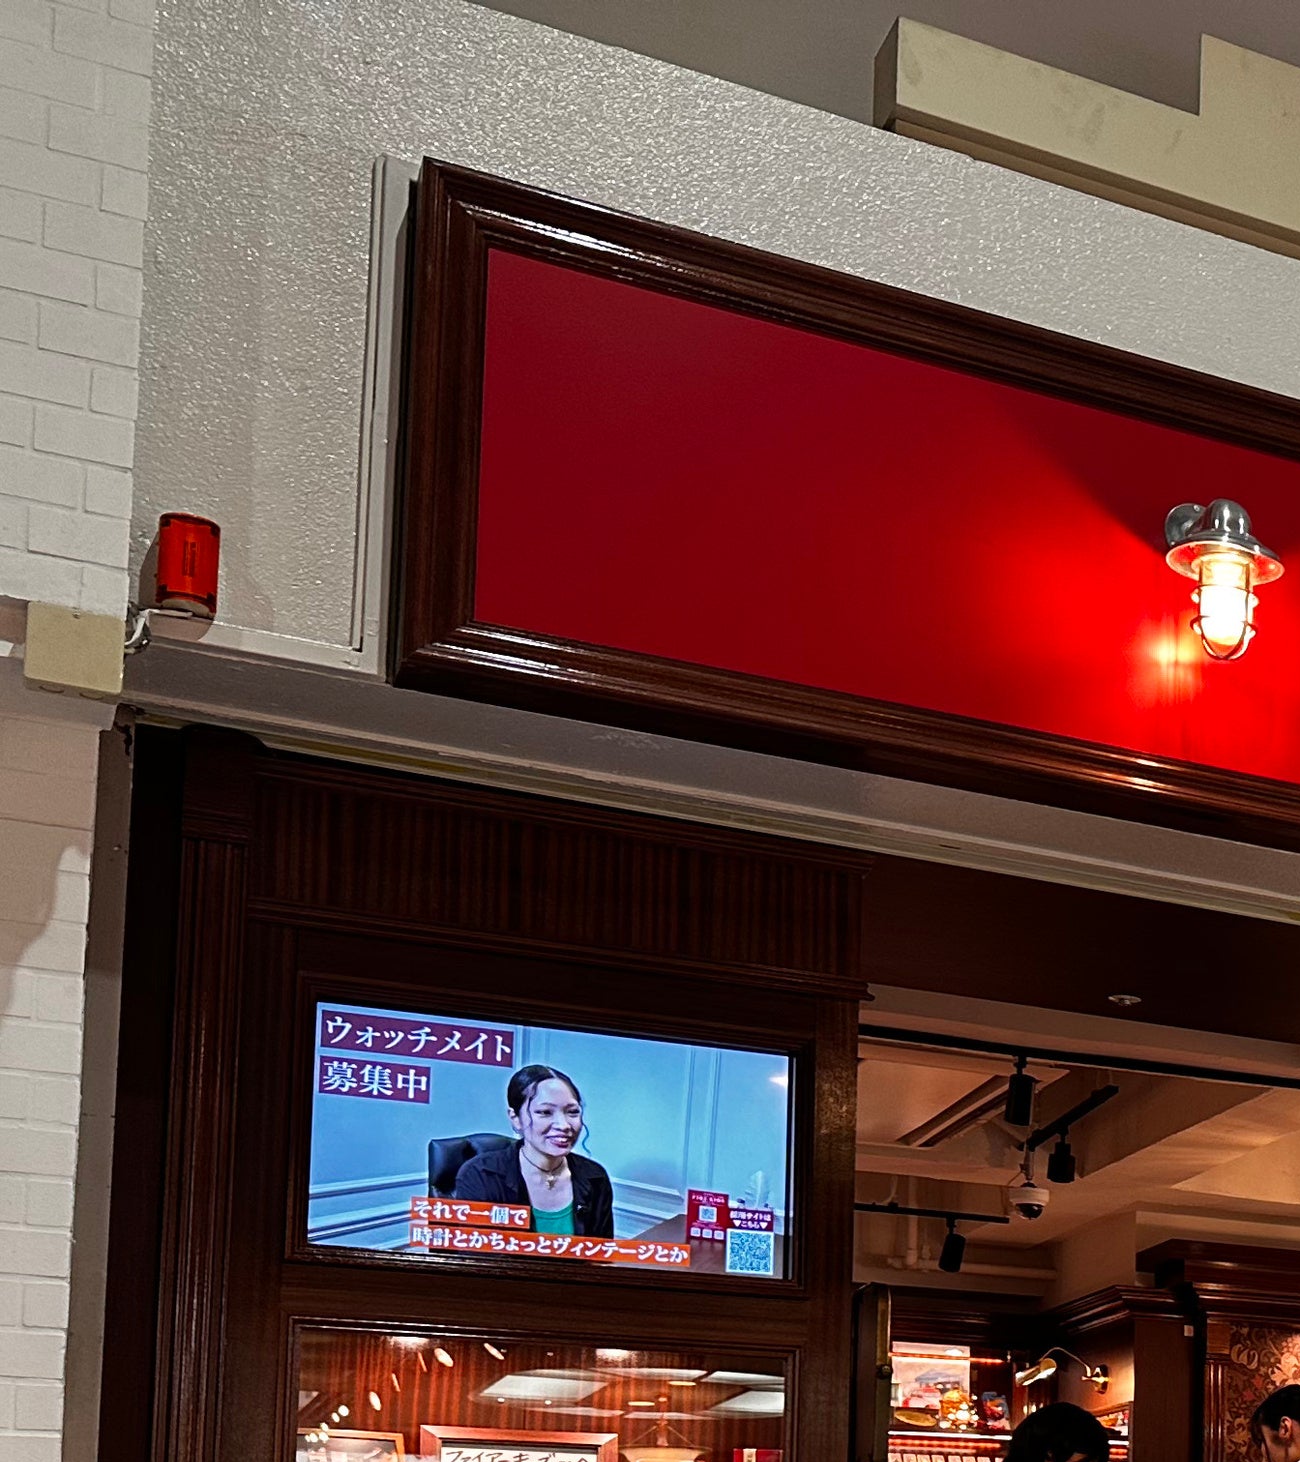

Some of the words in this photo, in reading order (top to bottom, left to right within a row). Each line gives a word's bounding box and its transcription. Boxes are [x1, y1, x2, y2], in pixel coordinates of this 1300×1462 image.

[324, 1016, 513, 1063] ウォッチメイト
[321, 1060, 428, 1099] 募集中
[413, 1198, 528, 1227] それで一個で
[412, 1226, 689, 1265] 時計とかちょっとヴィンテージとか
